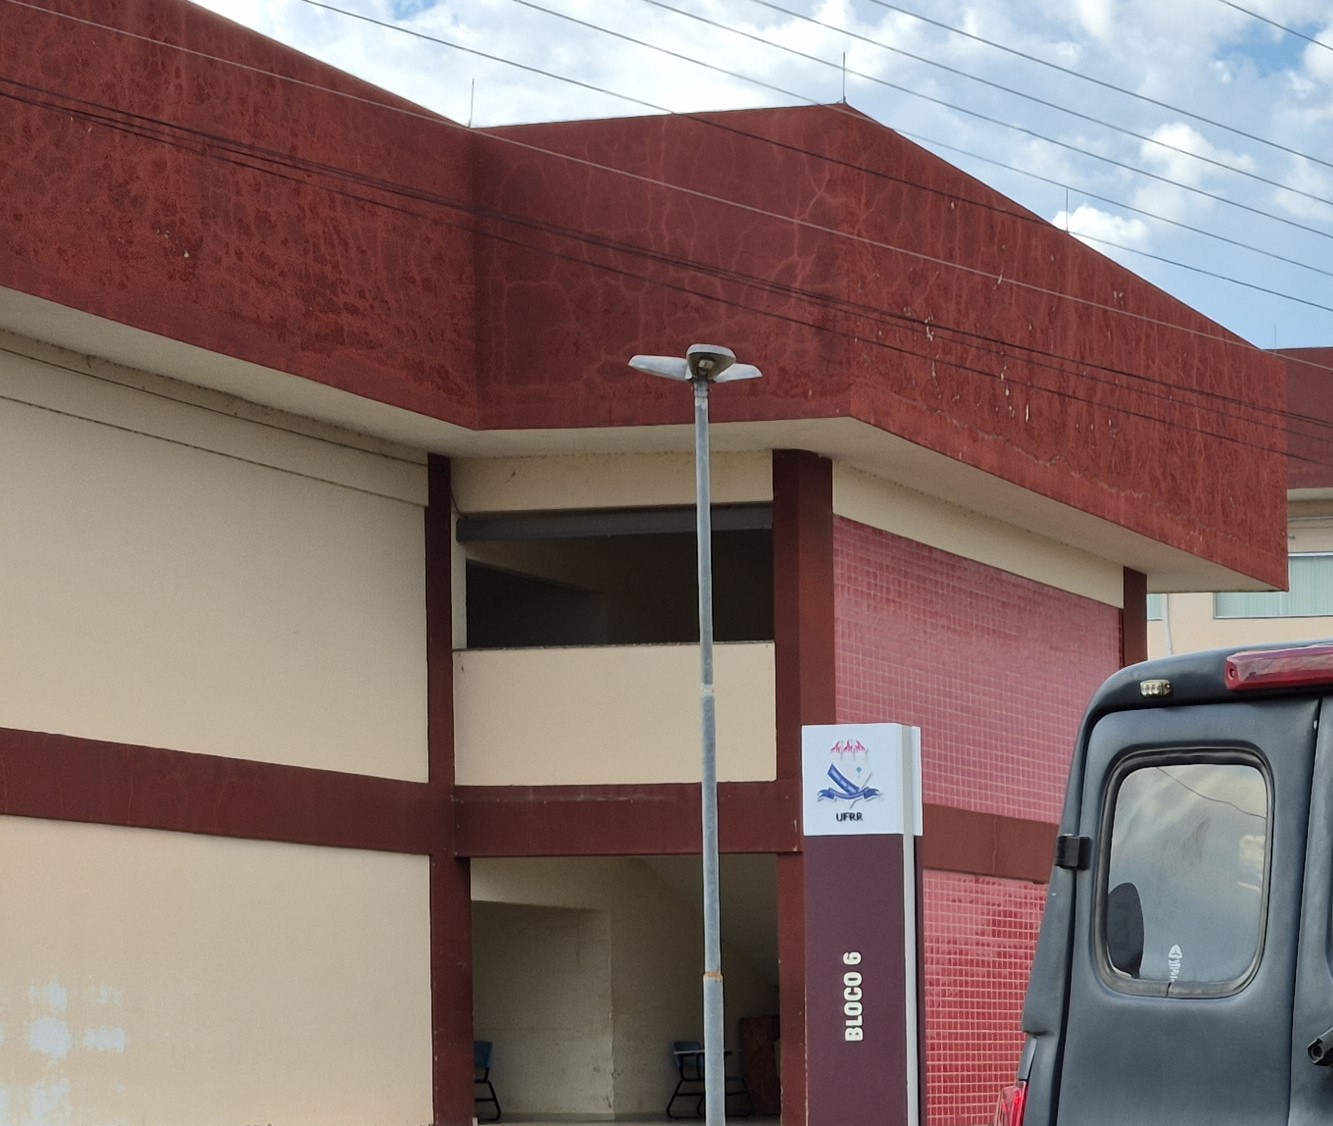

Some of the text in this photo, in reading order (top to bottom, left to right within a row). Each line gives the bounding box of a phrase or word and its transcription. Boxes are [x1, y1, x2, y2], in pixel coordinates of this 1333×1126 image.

[836, 811, 864, 822] UFRR
[842, 951, 863, 1041] BLOCO 6
